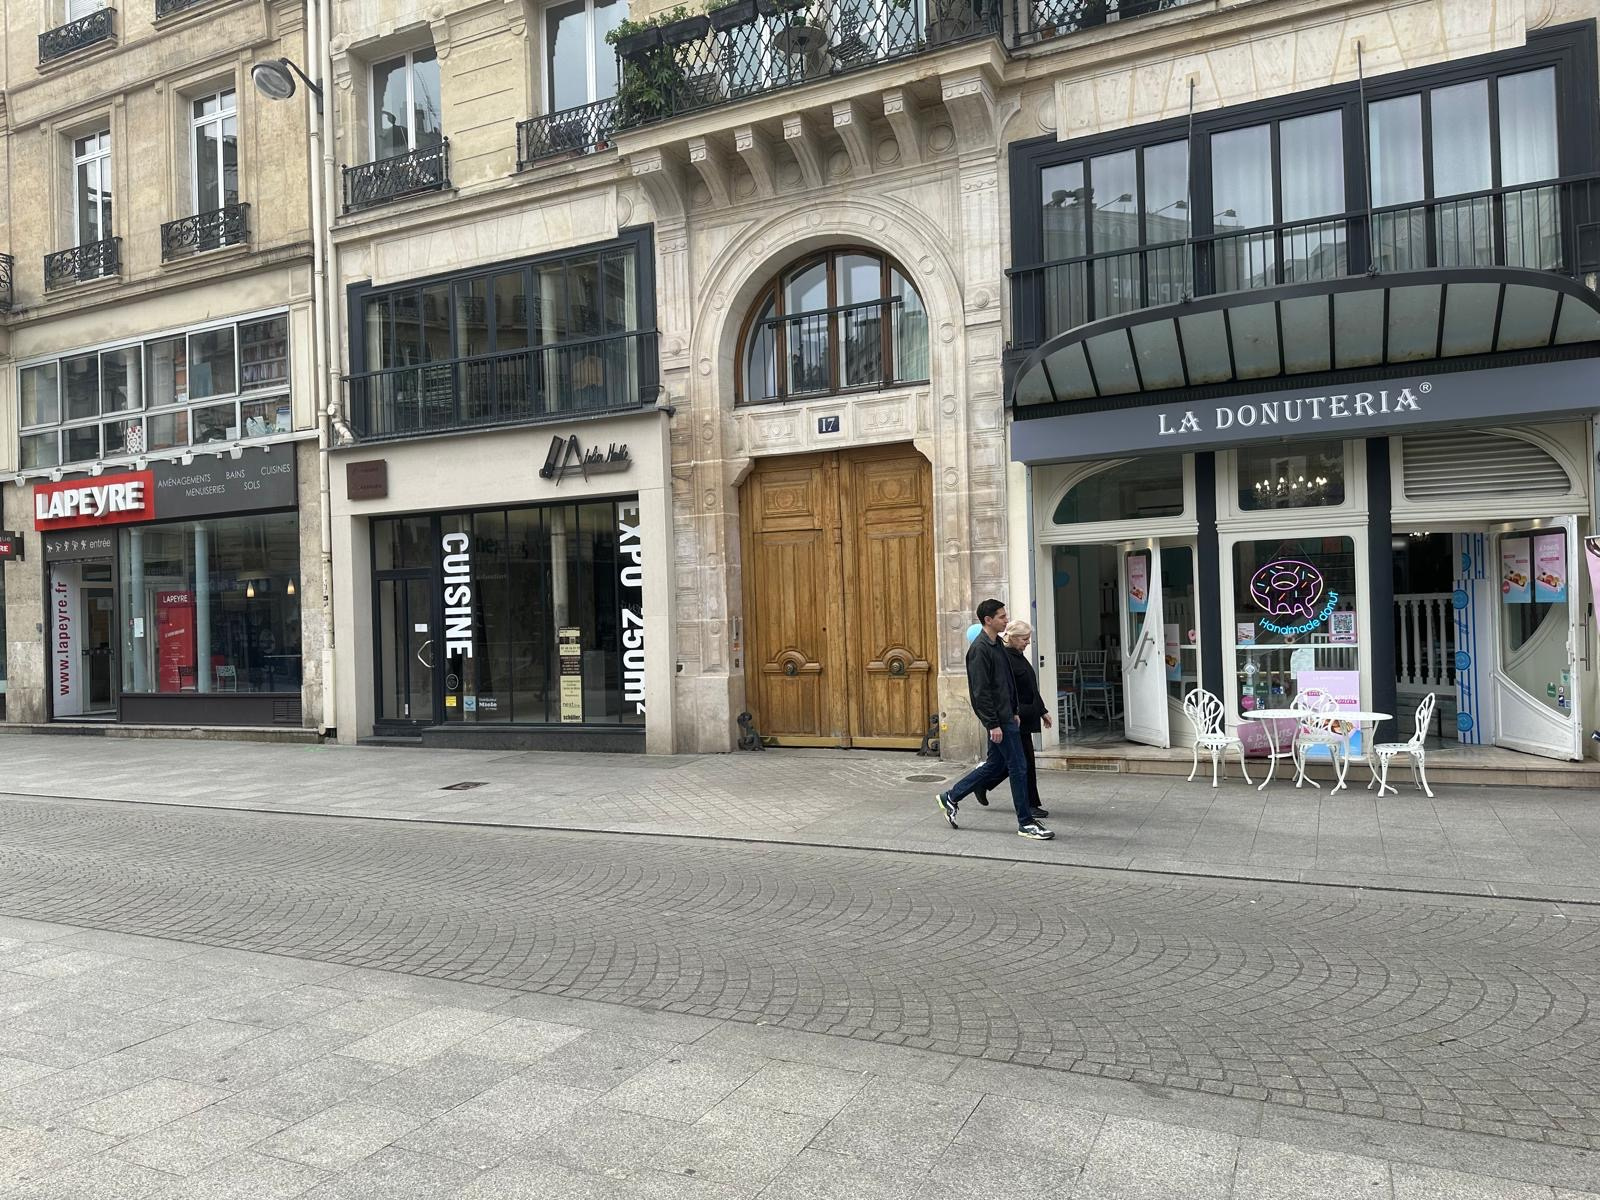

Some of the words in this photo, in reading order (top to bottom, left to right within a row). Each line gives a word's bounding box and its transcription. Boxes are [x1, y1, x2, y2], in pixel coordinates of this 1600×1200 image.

[821, 417, 835, 432] 17
[1157, 410, 1203, 436] LA
[225, 469, 246, 480] BAINS
[260, 463, 291, 476] CUISINES
[185, 484, 226, 497] MENUISERIES
[243, 480, 261, 491] SOLS
[35, 481, 145, 520] LAPEYRE
[89, 539, 111, 549] entrée
[162, 594, 188, 603] LAPEYRE
[442, 532, 473, 659] CUISINE
[1258, 617, 1321, 635] Handmade
[1318, 590, 1339, 621] donut
[55, 581, 71, 696] www.lapeyre.fr
